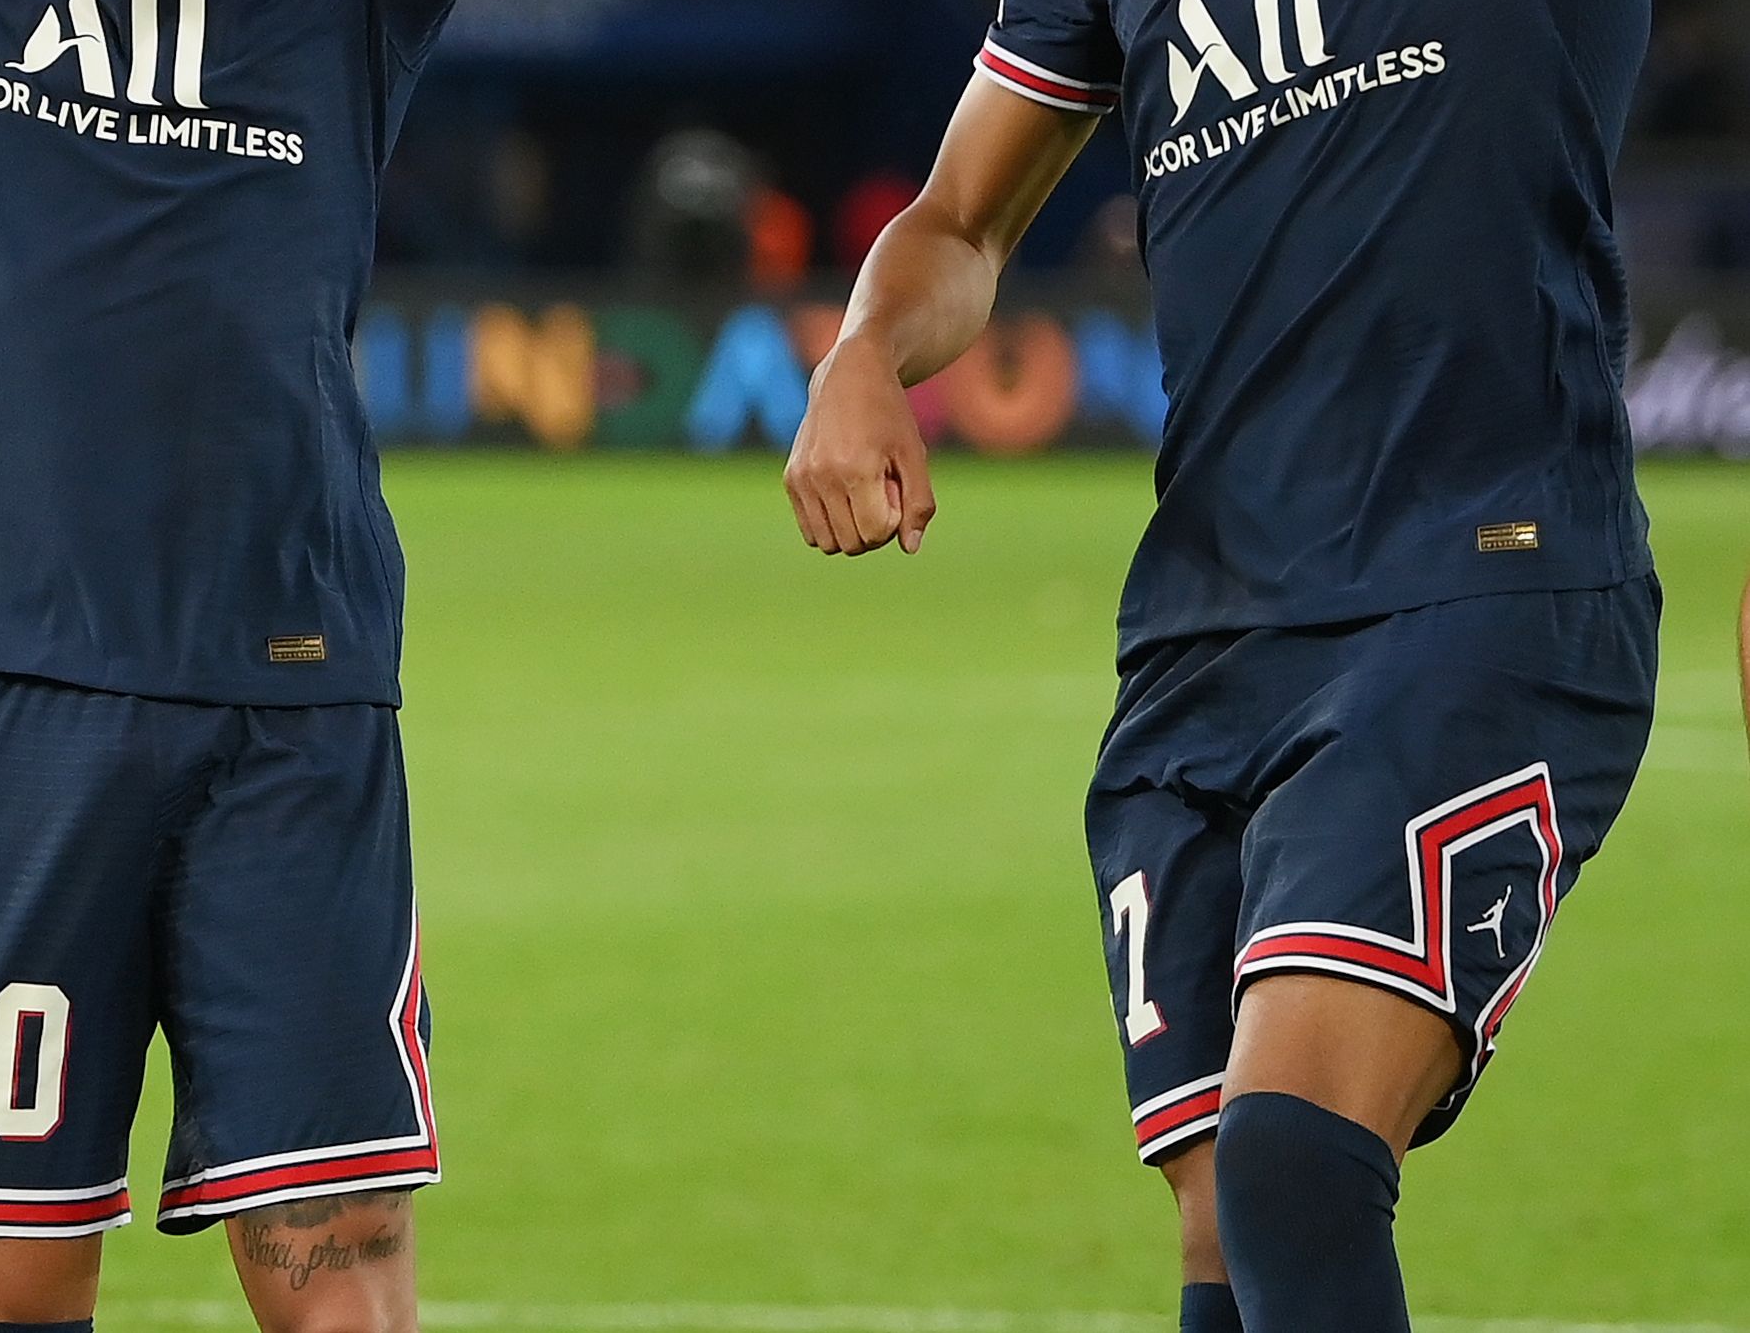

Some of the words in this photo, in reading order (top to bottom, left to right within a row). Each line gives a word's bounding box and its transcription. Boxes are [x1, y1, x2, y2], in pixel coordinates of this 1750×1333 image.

[36, 96, 120, 142] LIVE
[128, 114, 305, 165] LIMITLESS
[1144, 134, 1201, 182] COR
[1200, 105, 1268, 158] LIVE
[1269, 40, 1446, 127] LIMITLESS
[1109, 869, 1168, 1048] 7
